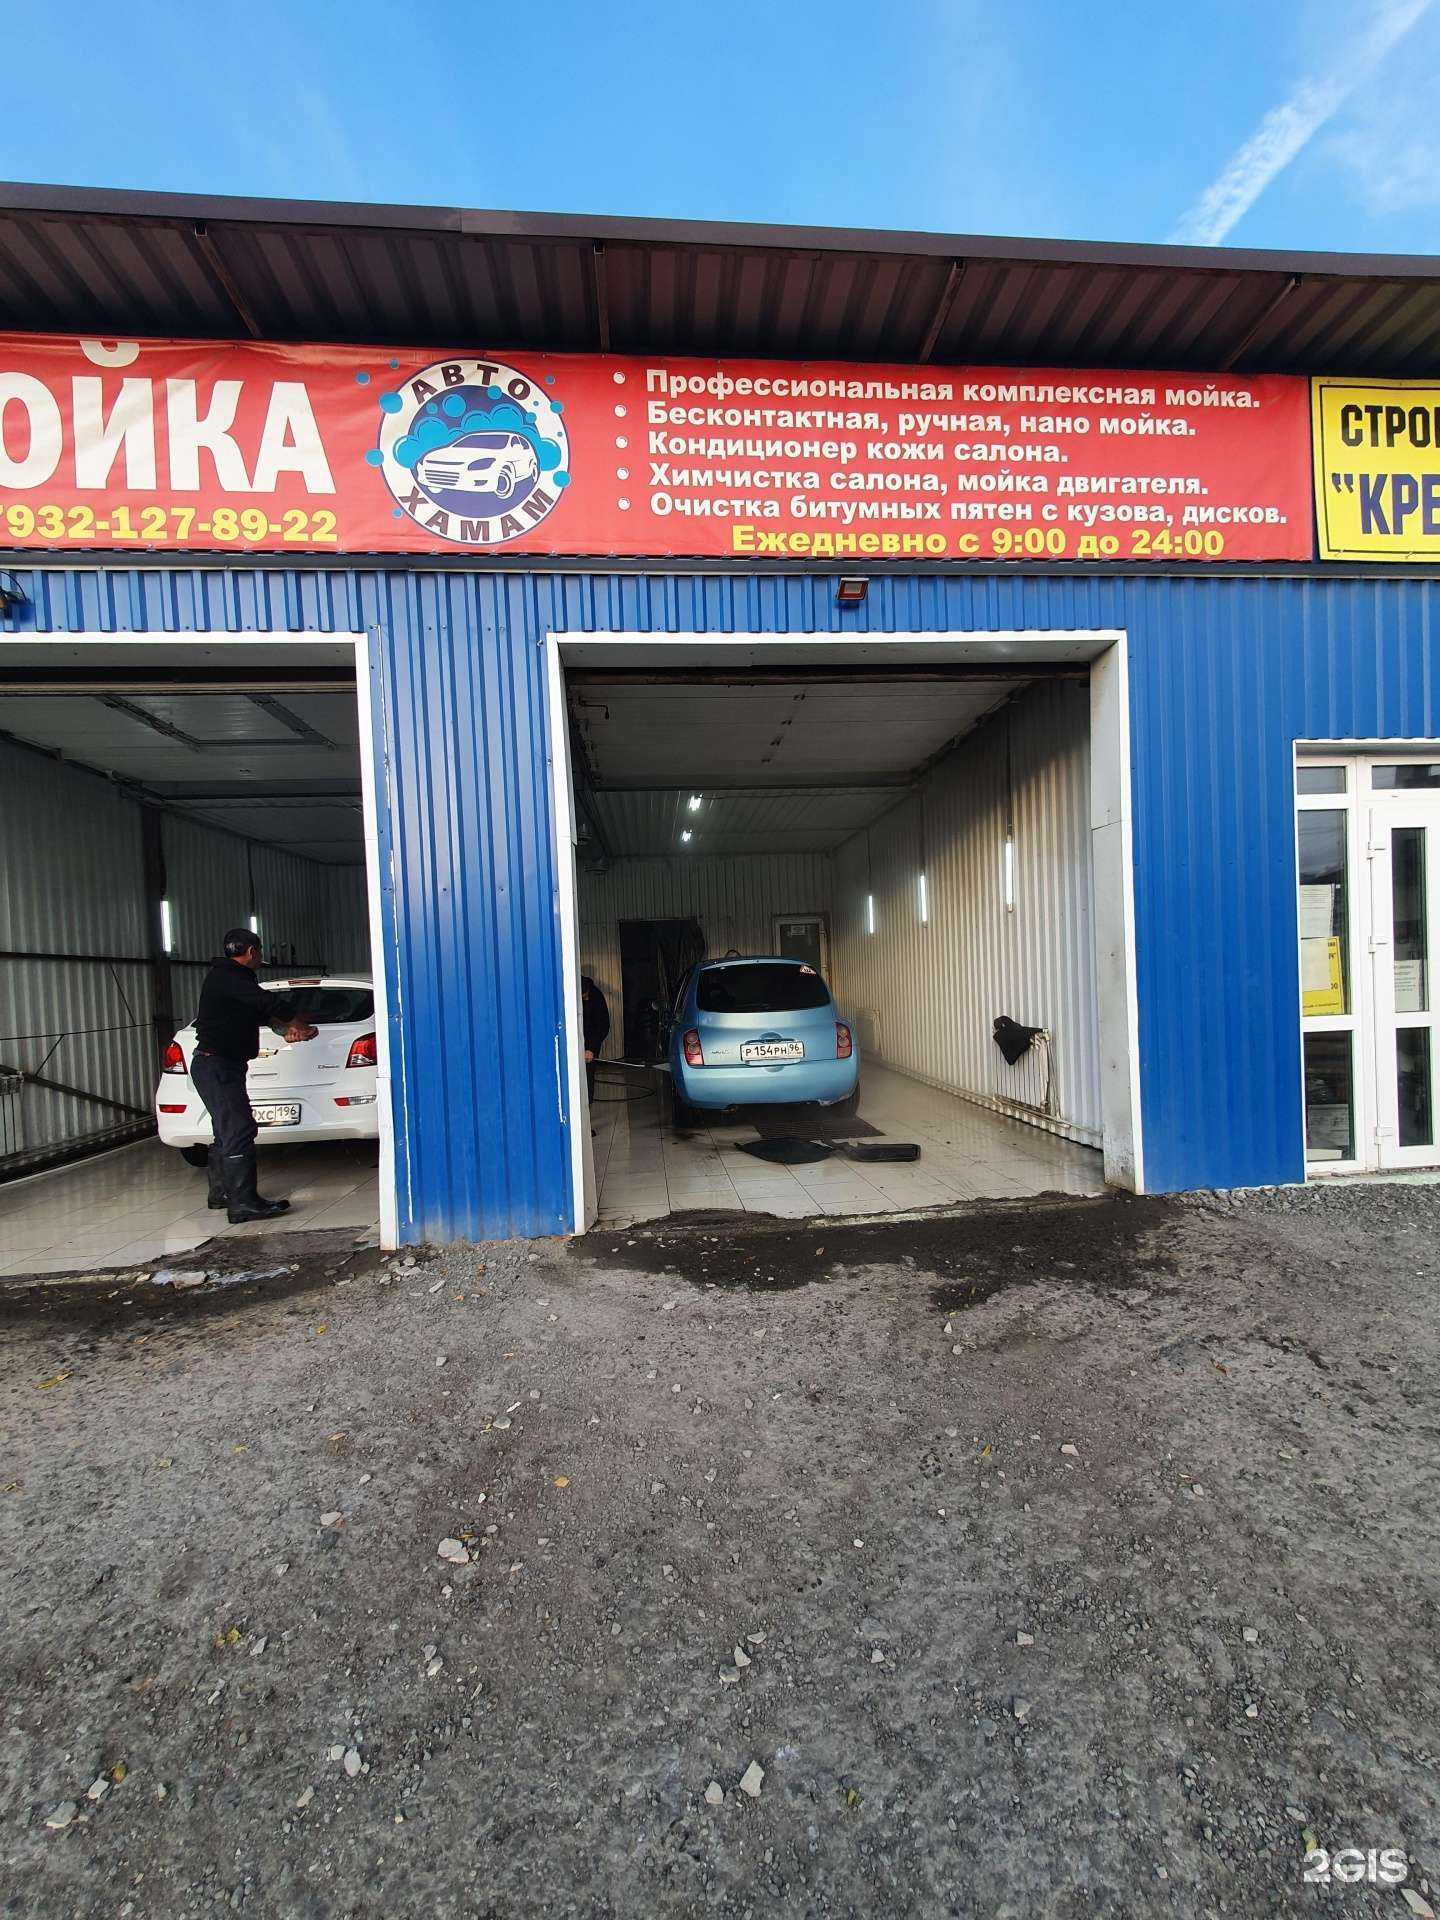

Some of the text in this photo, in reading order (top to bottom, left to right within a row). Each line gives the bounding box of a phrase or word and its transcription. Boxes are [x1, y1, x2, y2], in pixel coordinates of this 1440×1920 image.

[411, 363, 530, 405] АВТО
[646, 369, 1260, 408] Профессиональная комплексная мойка.
[647, 400, 1196, 437] Бесконтактная, ручная, нано мойка.
[1340, 404, 1440, 449] СТРО
[648, 430, 1068, 465] Кондиционер кожи салона.
[648, 462, 1209, 497] Химчистка салона, мойка двигателя.
[0, 504, 338, 542] 932-127-89-22
[398, 486, 554, 542] ХАМАМ
[650, 491, 1287, 528] Очистка битумных пятен с кузова, дисков.
[732, 524, 1225, 559] Ежедневно с 9:00 до 24:00
